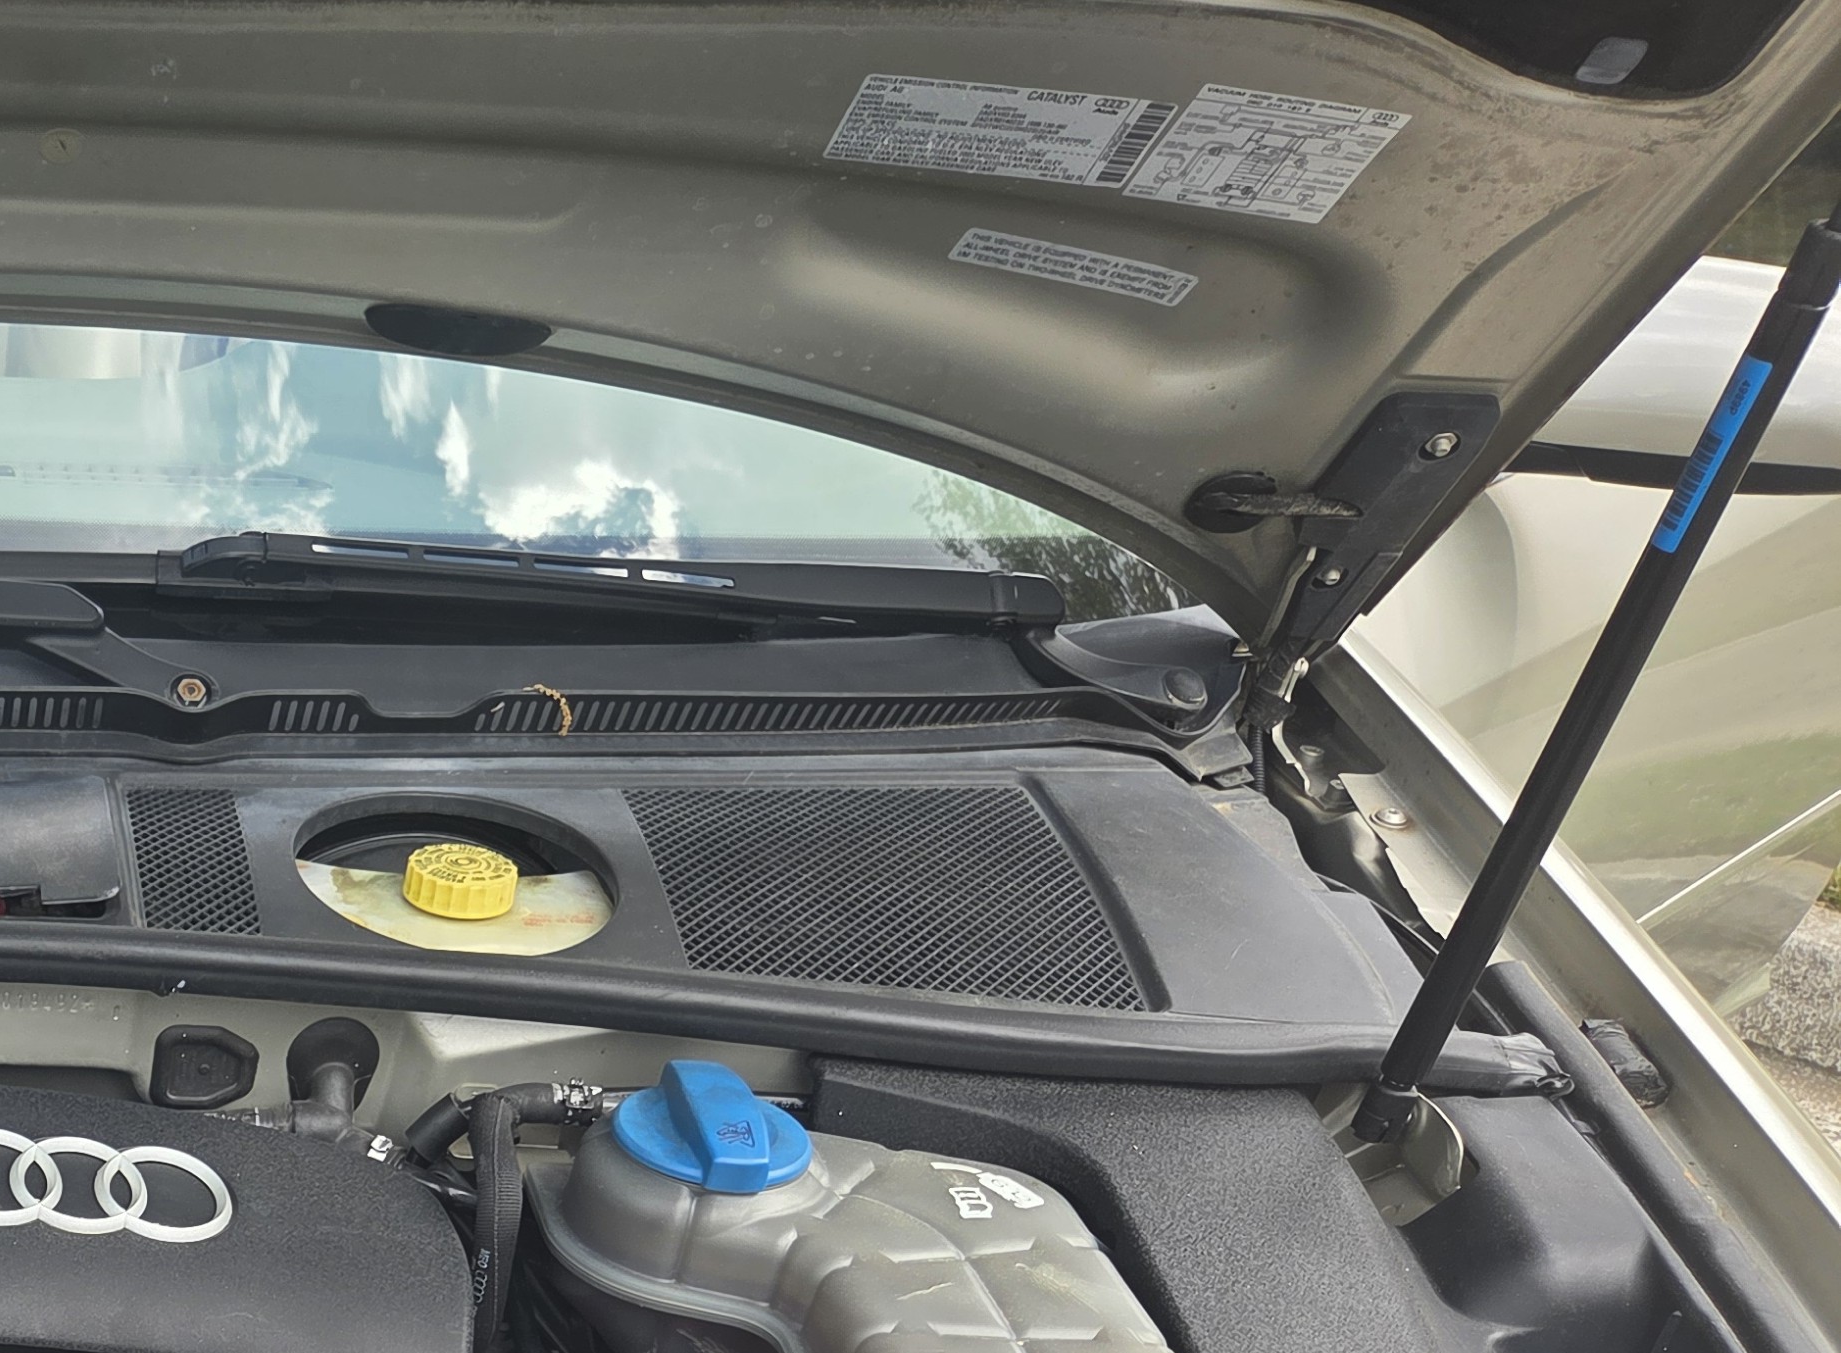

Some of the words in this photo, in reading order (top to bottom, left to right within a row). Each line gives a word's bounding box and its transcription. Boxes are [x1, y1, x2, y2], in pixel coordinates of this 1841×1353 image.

[864, 83, 888, 92] AUDI
[1027, 90, 1088, 106] CATALYST
[1207, 86, 1247, 97] VACUUM
[972, 232, 993, 243] THIS
[993, 236, 1030, 251] VEHICLE
[1042, 246, 1087, 262] EQUIPPED
[1088, 256, 1111, 268] WITH
[1120, 262, 1174, 282] PERMANENT
[973, 252, 1009, 267] TESTING
[1010, 259, 1025, 270] ON
[1079, 273, 1106, 287] DRIVE
[1013, 251, 1039, 263] DRIVE
[1042, 256, 1077, 270] SYSTEM
[1078, 263, 1097, 274] AND
[1109, 269, 1145, 285] EXEMPT
[1146, 279, 1172, 292] FROM
